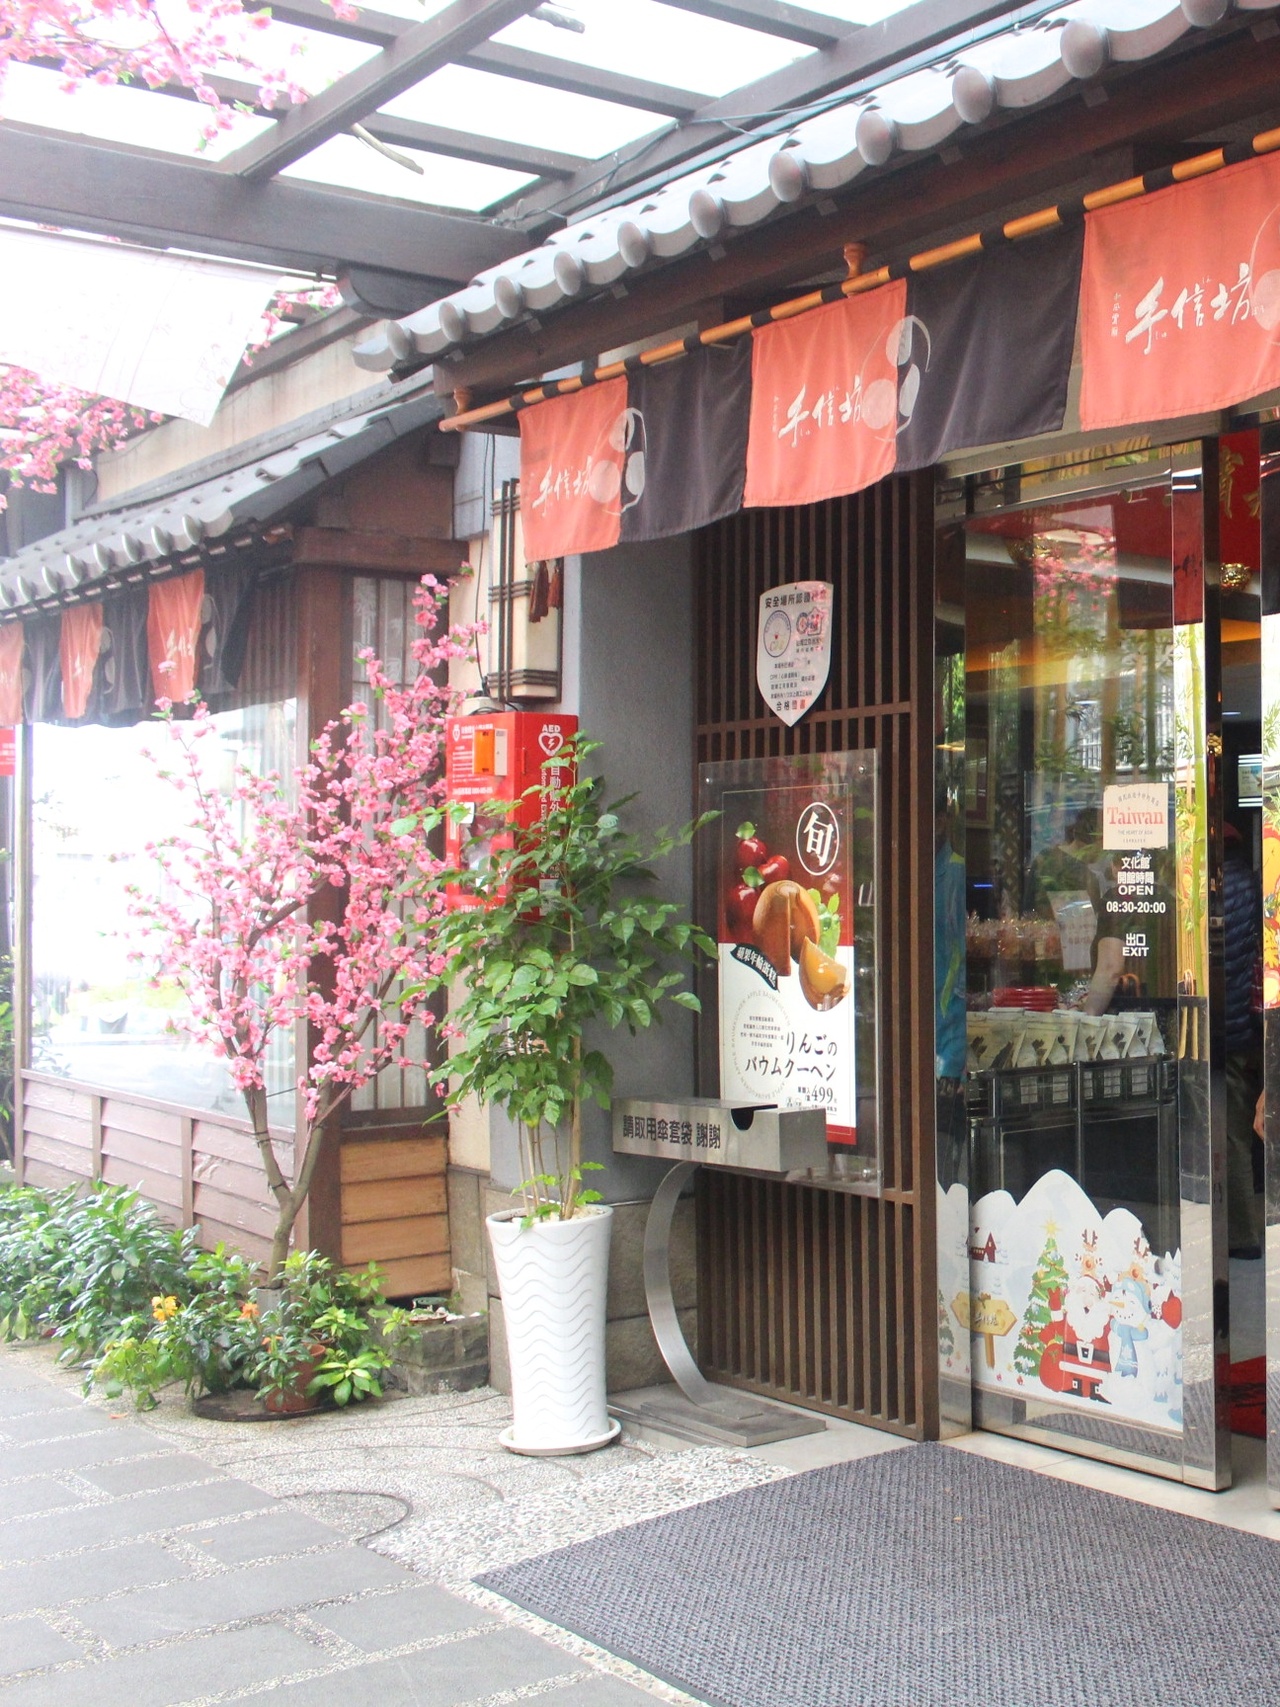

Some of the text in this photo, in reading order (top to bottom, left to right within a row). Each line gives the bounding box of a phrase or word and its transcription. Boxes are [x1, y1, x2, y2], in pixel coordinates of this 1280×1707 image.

[542, 724, 561, 733] AED
[1107, 806, 1165, 825] Taiwan
[804, 812, 834, 867] 旬
[1121, 857, 1151, 870] 文化館
[1117, 871, 1155, 885] 開館時間
[1118, 885, 1154, 896] OPEN
[1106, 901, 1166, 913] 08:30-20:00
[1125, 933, 1146, 947] 出口
[1122, 947, 1149, 957] EXIT
[786, 1031, 838, 1056] りんごの
[811, 1084, 834, 1104] 499
[623, 1114, 721, 1149] 請取用傘套袋 謝謝
